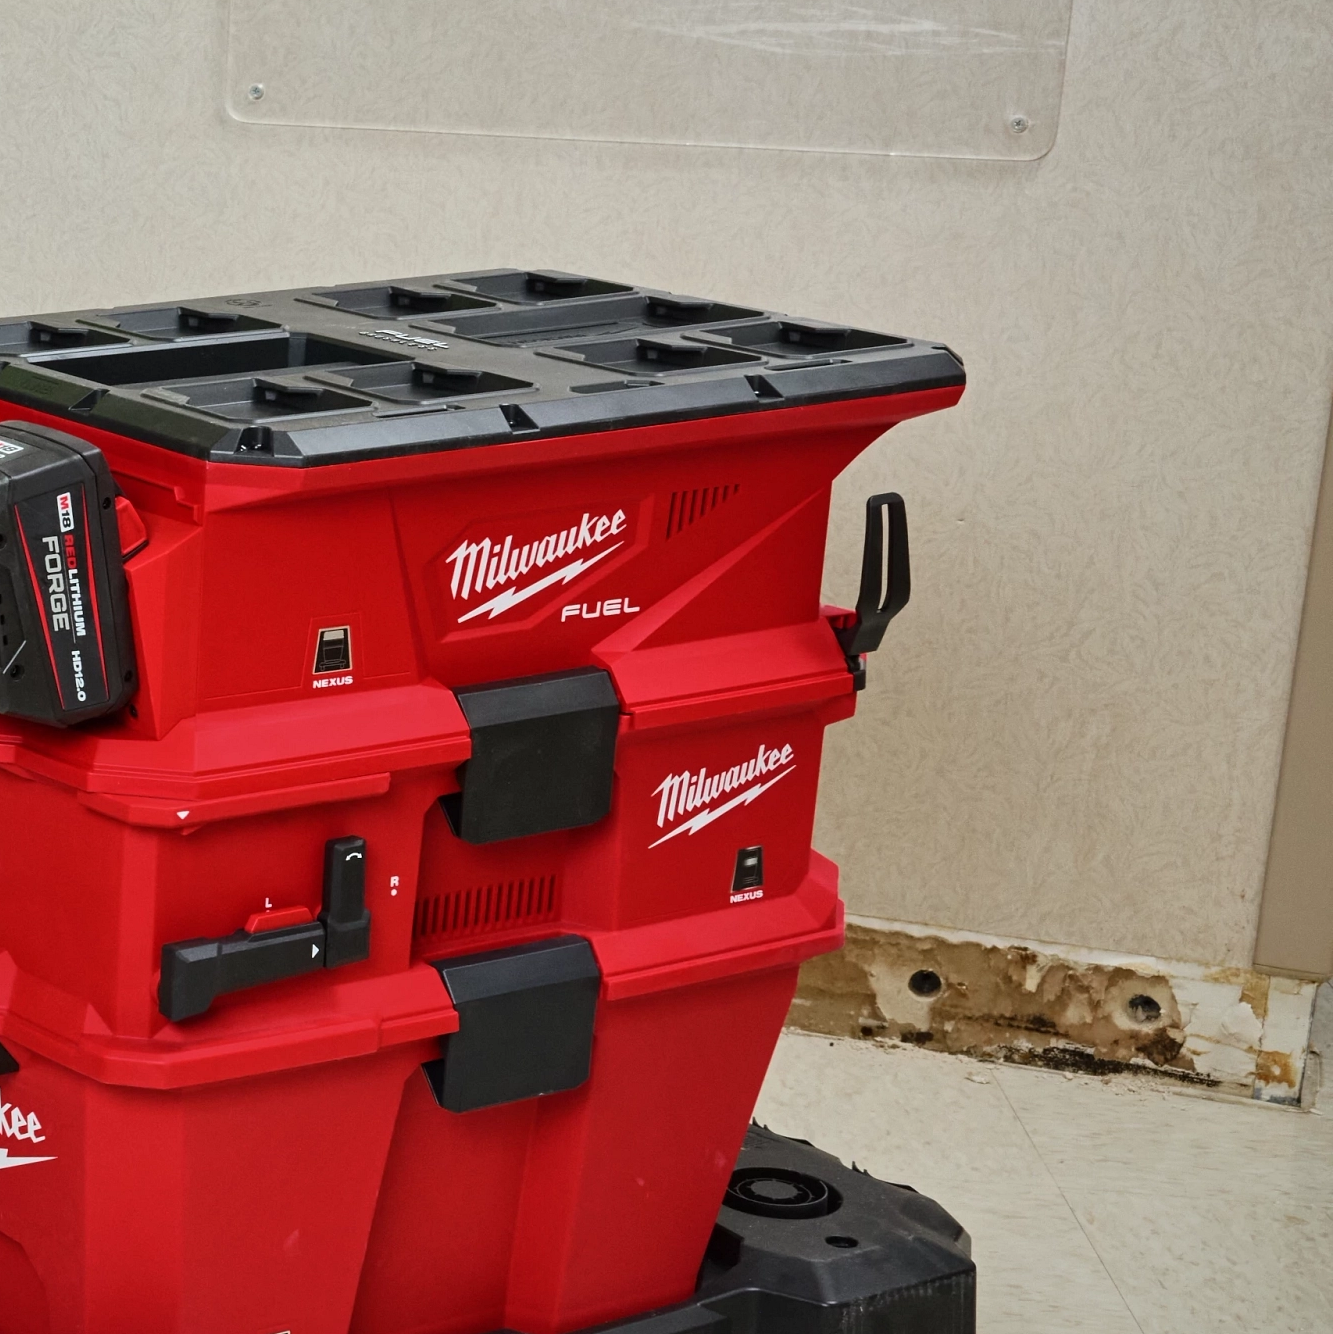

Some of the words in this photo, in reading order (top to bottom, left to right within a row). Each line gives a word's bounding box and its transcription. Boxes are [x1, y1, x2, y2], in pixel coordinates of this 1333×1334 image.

[59, 495, 72, 529] M18
[445, 509, 627, 601] Milwaukee
[42, 535, 70, 632] FORGE
[64, 534, 87, 637] REDLITHIUM
[561, 597, 640, 623] FUEL
[71, 649, 87, 703] HD12.0
[312, 675, 354, 689] NEXUS
[650, 743, 795, 829] Milwaukee
[390, 875, 400, 888] R
[729, 889, 764, 904] NEXUS
[264, 897, 273, 909] L
